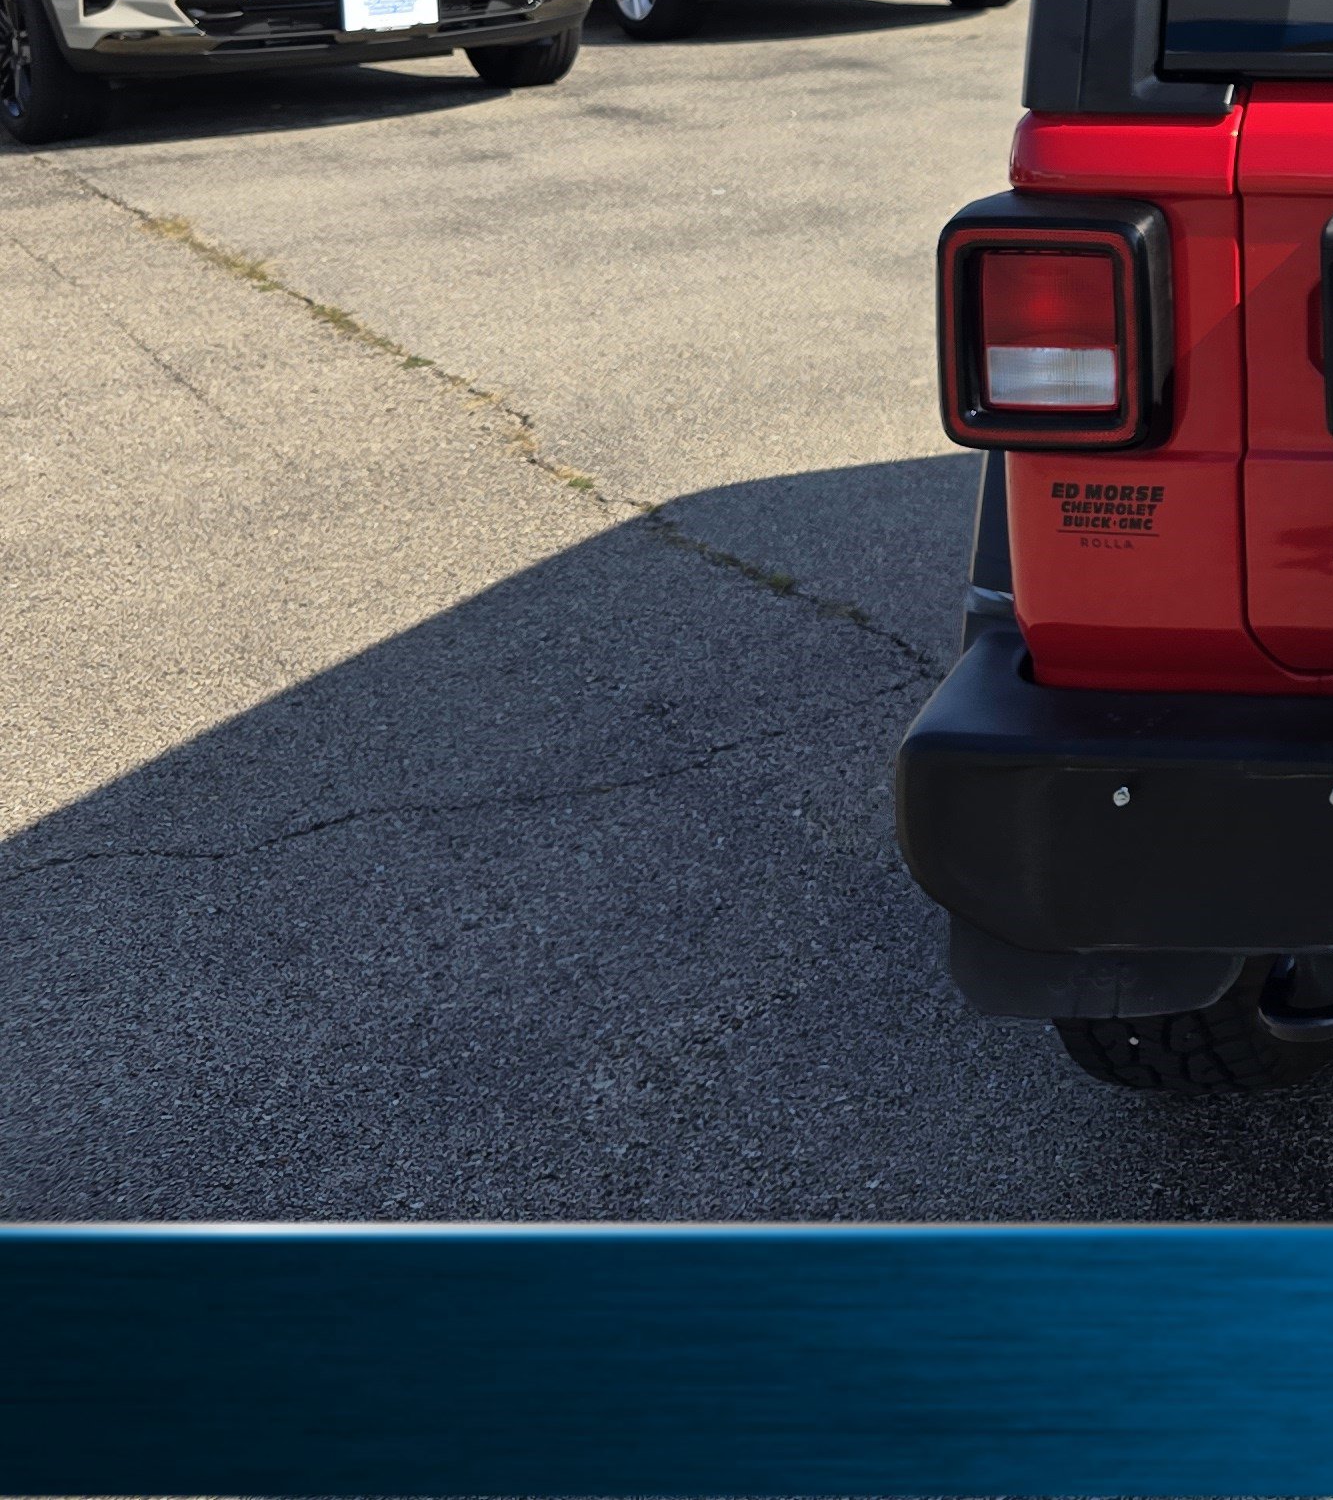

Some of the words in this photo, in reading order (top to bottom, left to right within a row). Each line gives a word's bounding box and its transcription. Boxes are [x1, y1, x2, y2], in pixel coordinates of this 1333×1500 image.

[1051, 482, 1080, 499] ED
[1085, 483, 1165, 503] MORSE
[1061, 500, 1157, 517] CHEVROLET
[1080, 537, 1134, 550] ROLLA
